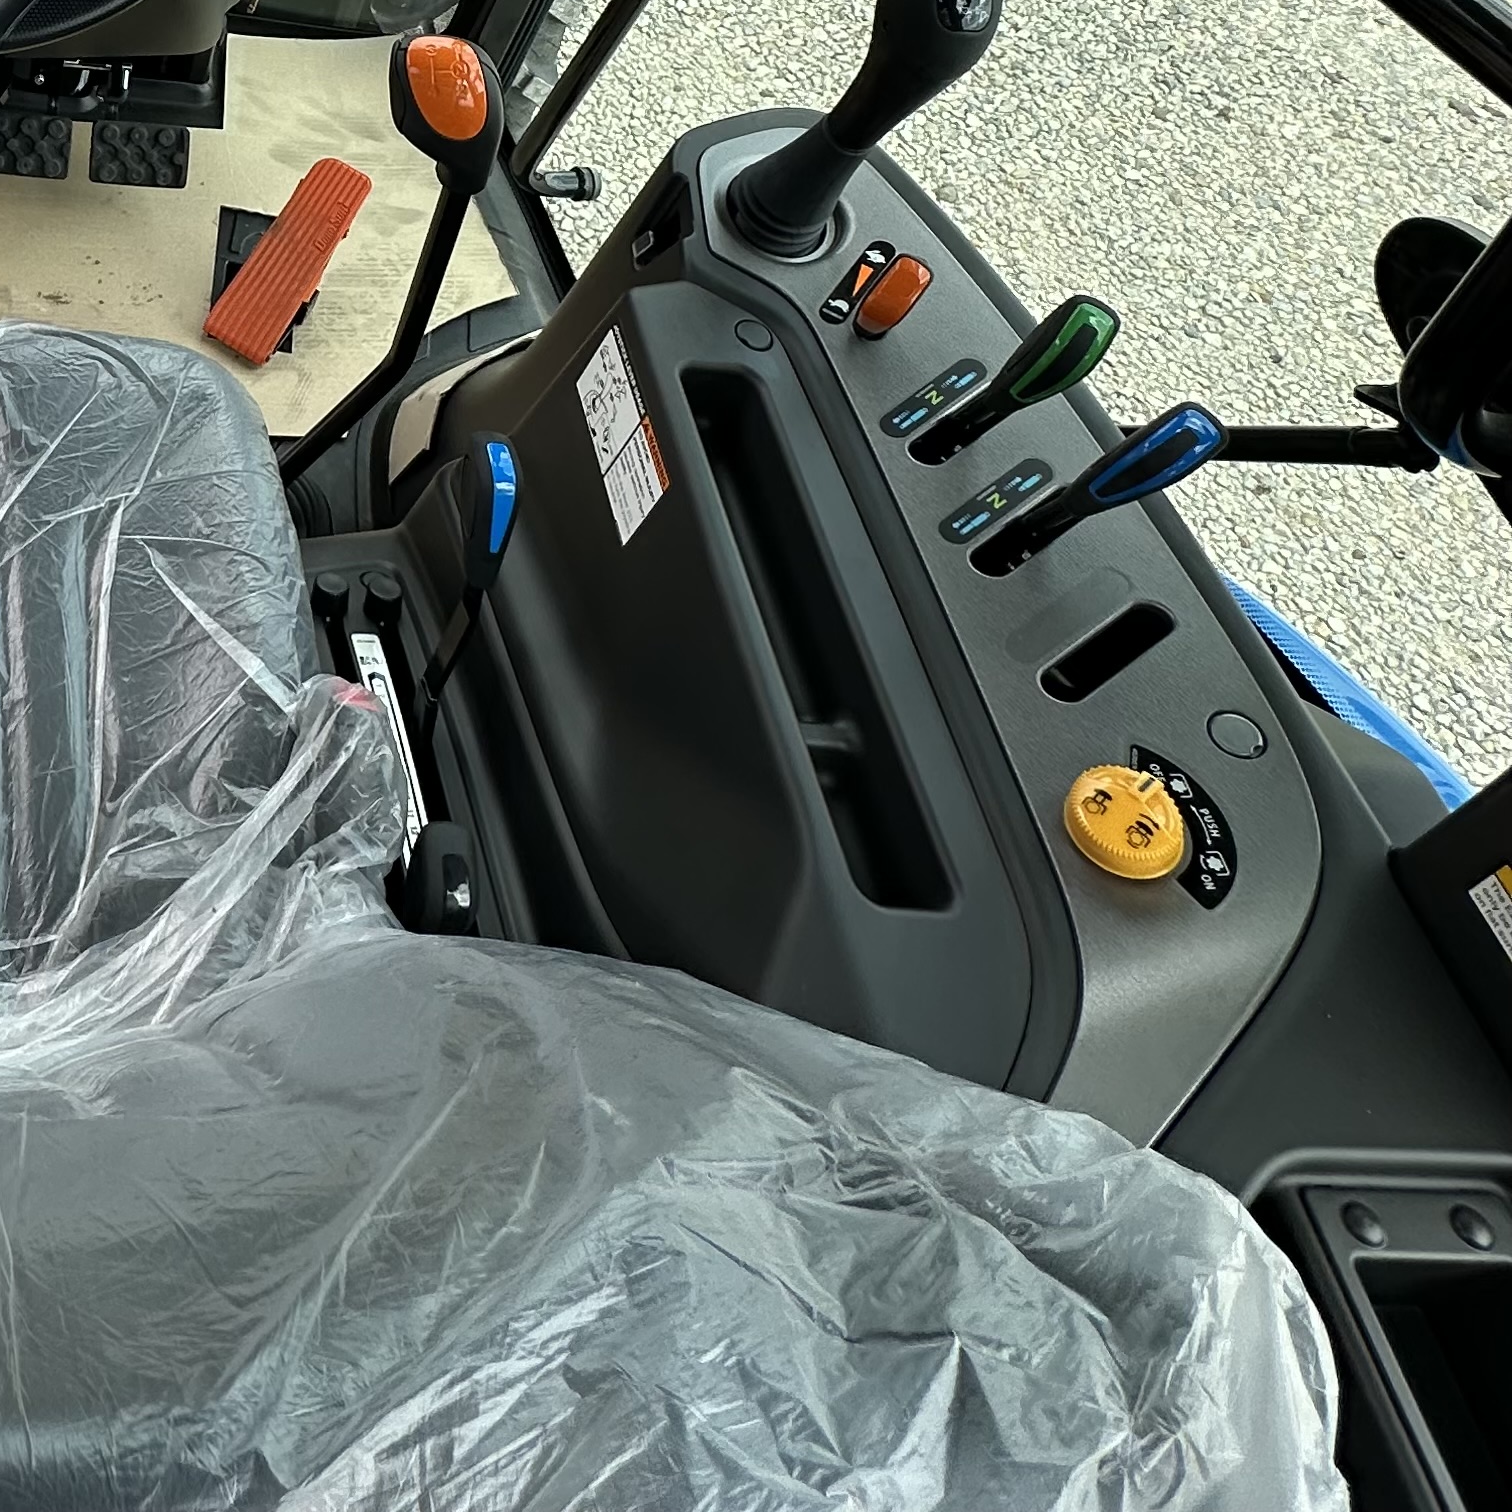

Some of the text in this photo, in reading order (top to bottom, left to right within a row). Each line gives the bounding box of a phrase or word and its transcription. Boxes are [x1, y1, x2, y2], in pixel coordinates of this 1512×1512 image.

[924, 390, 945, 406] N
[986, 492, 1008, 509] N
[1199, 808, 1221, 838] PUSH
[1200, 874, 1216, 890] ON
[1474, 893, 1486, 908] on
[1483, 888, 1500, 910] only
[1491, 881, 1505, 903] The
